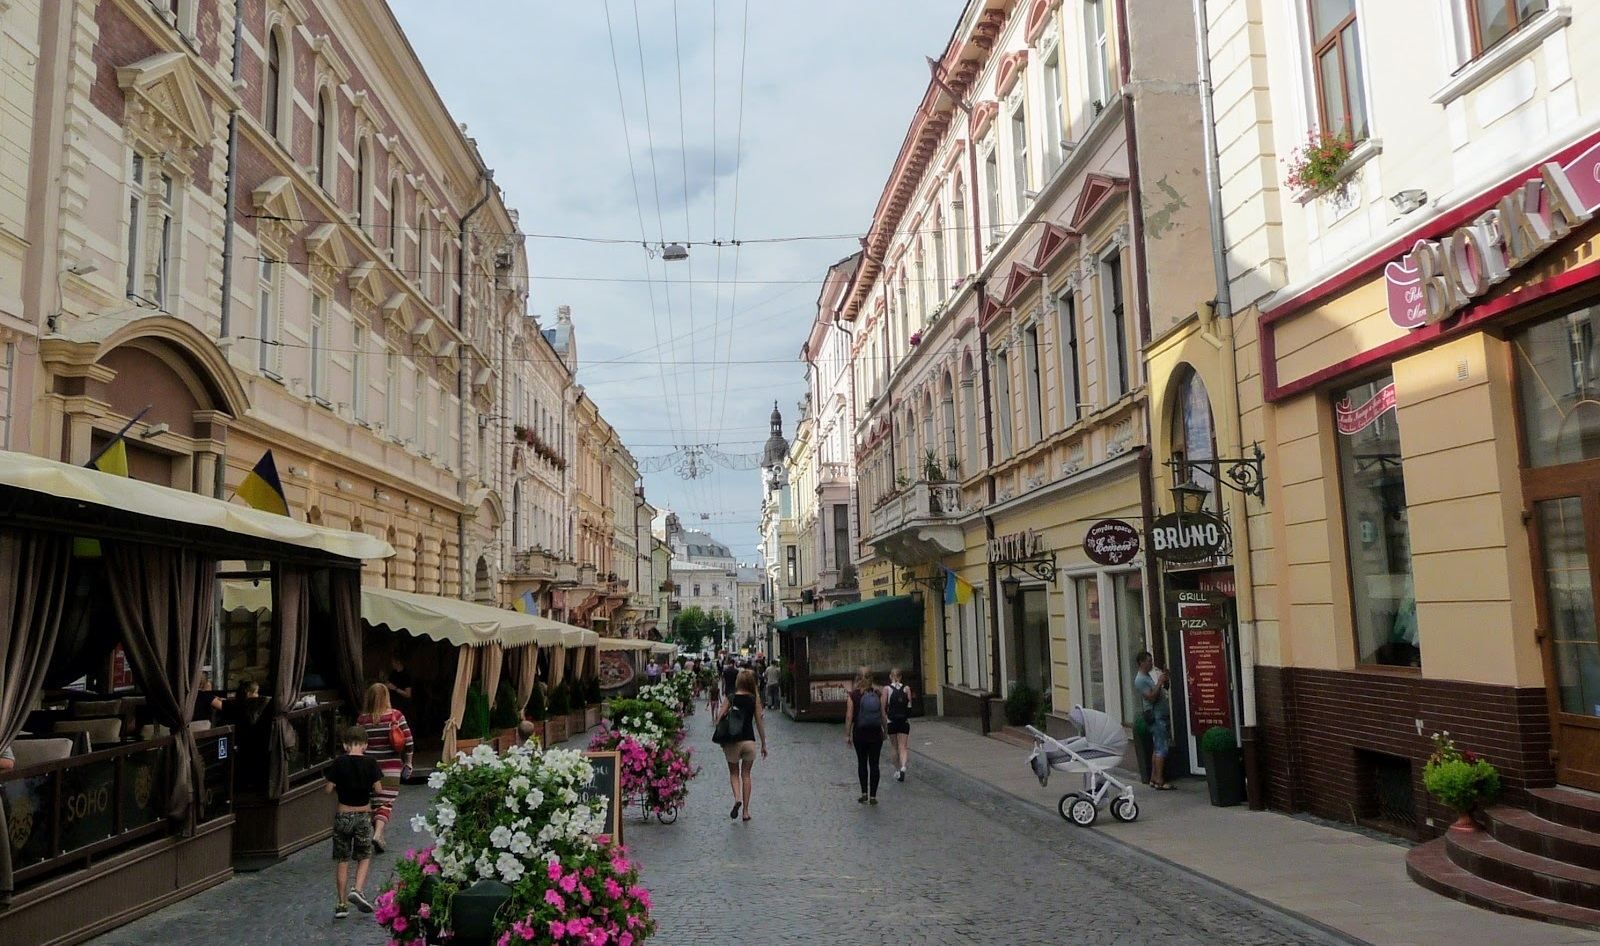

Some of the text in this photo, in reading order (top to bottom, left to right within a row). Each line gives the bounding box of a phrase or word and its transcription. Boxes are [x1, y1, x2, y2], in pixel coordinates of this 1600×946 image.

[1153, 517, 1219, 551] BRUNO
[1178, 592, 1207, 601] GRILL
[1180, 619, 1208, 629] PIZZA
[68, 790, 109, 821] SOHO
